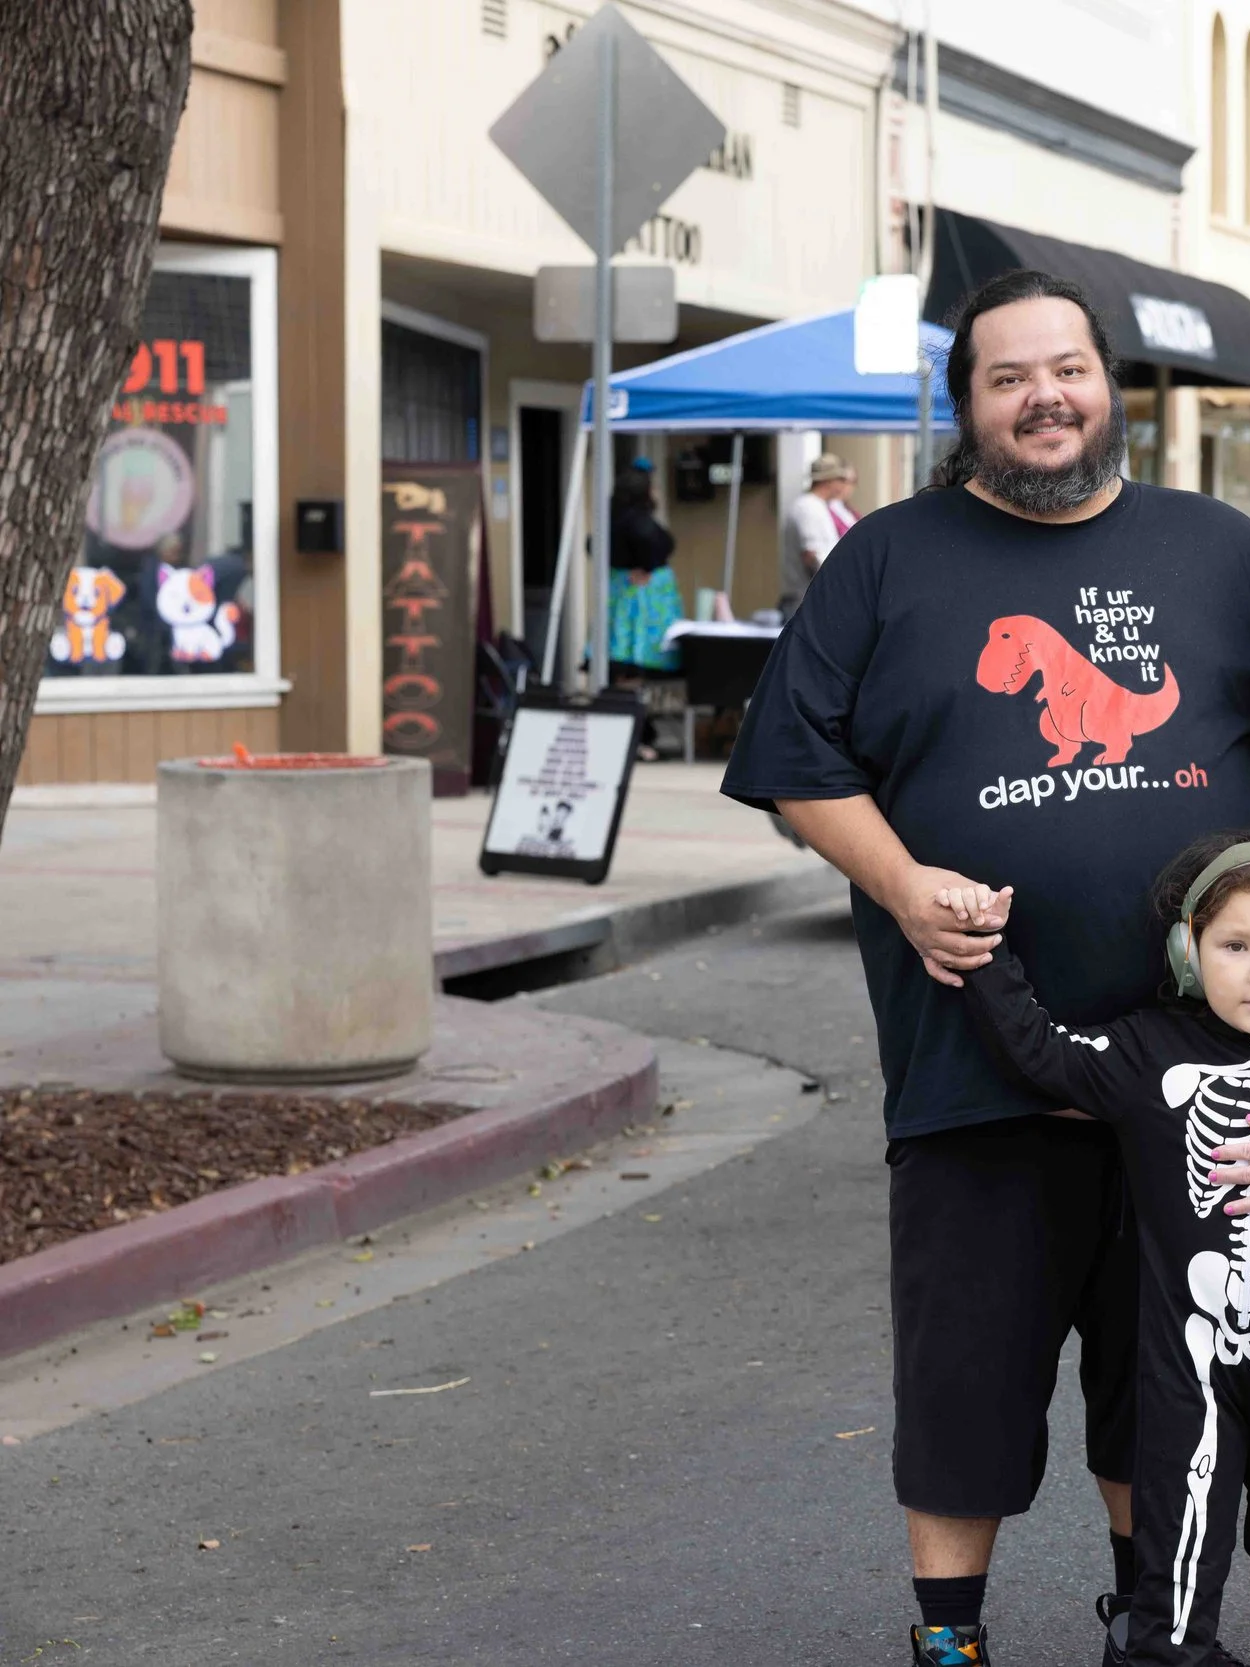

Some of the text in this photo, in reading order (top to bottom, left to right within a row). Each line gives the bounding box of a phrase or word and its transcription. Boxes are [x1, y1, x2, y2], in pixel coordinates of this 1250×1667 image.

[142, 400, 229, 426] RESCUE
[1080, 587, 1133, 606] If ur
[1075, 605, 1155, 626] happy
[1095, 625, 1139, 643] & u
[1090, 644, 1160, 664] know
[1140, 662, 1159, 682] it
[979, 763, 1208, 809] clap your... oh
